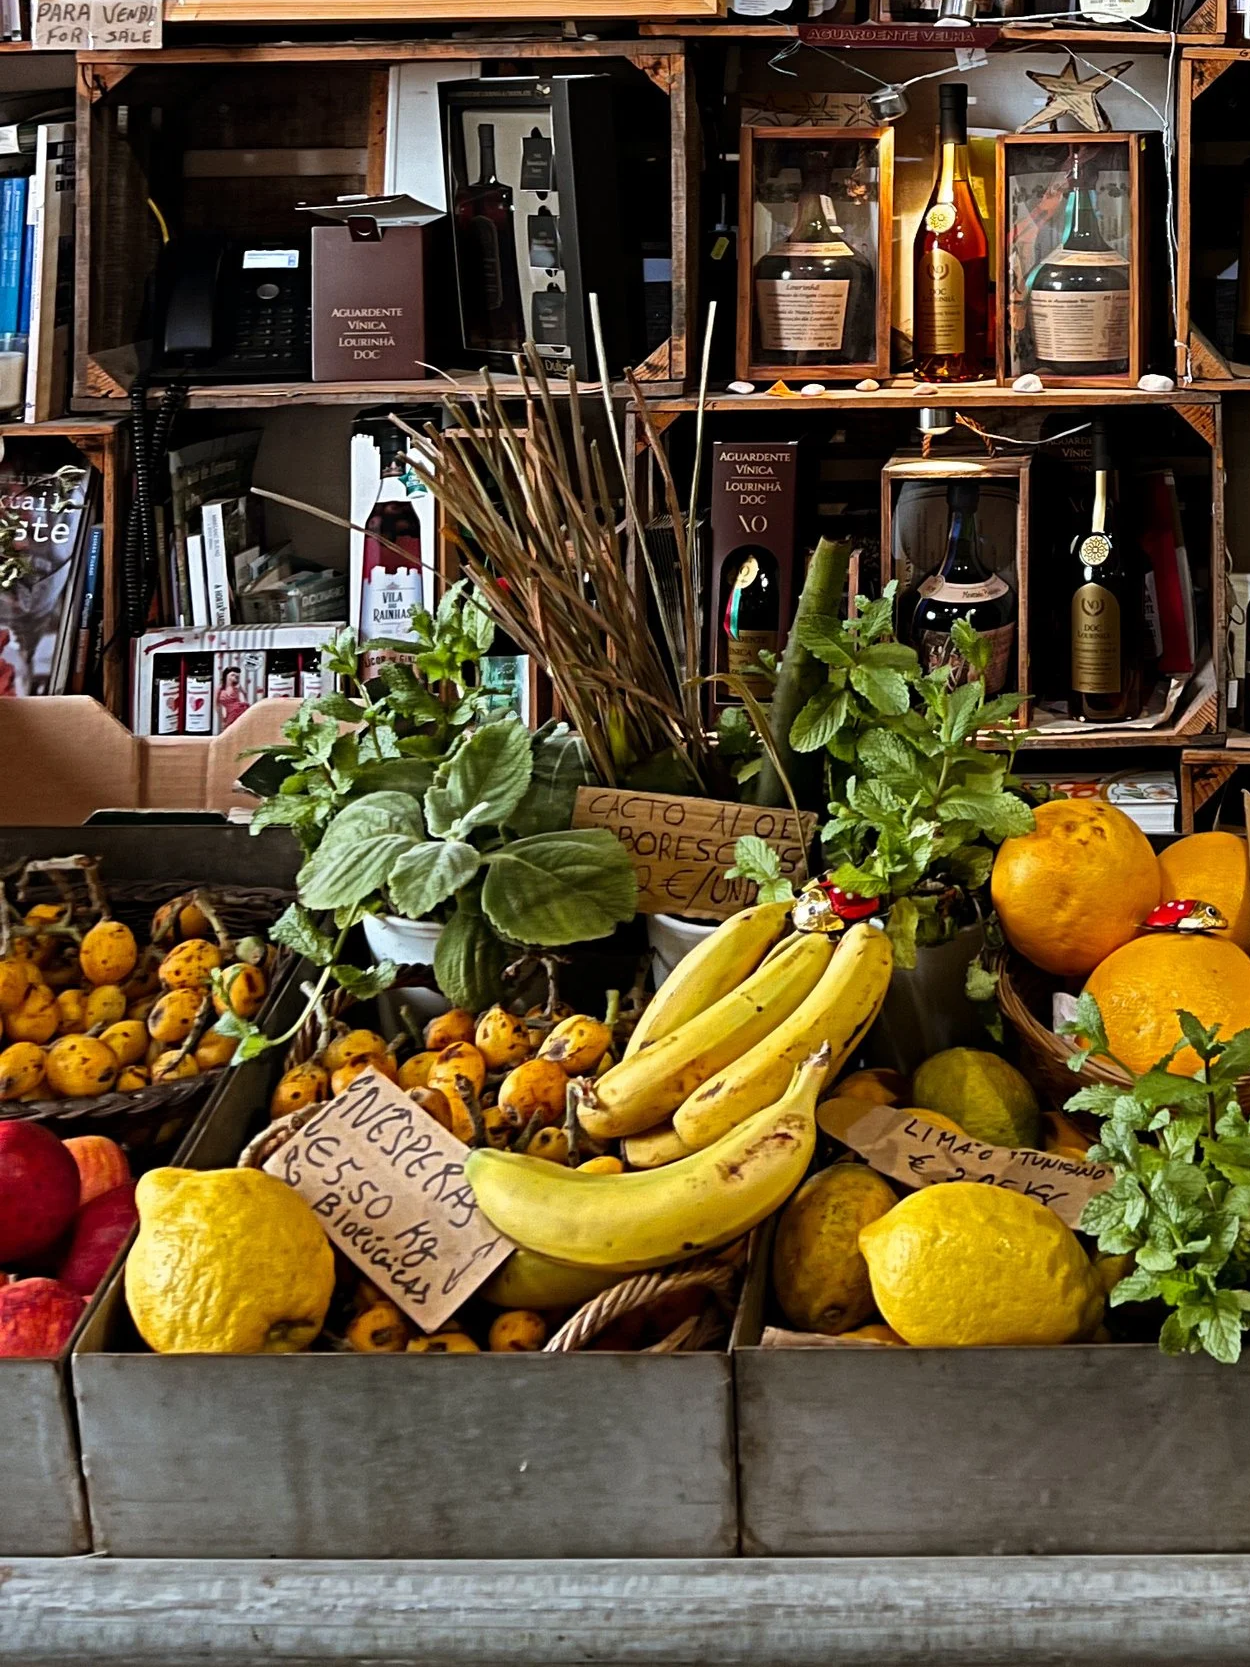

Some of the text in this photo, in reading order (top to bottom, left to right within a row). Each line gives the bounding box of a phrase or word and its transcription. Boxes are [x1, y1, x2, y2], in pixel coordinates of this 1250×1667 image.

[36, 2, 91, 24] PARA
[46, 25, 153, 45] FOR SALE
[805, 27, 976, 42] AGUARDENTE VELHA
[331, 307, 403, 318] AGUARDENTE
[347, 319, 387, 331] VÍNICA
[338, 336, 396, 348] LOURINHÃ
[354, 349, 381, 360] DOC
[718, 450, 792, 464] AGUARDENTE
[734, 462, 774, 476] VÍNICA
[725, 480, 782, 493] LOURINHÃ
[739, 494, 767, 505] DOC
[381, 591, 404, 605] VILA
[372, 608, 412, 622] RAINHAS
[1083, 624, 1101, 632] DOC
[588, 794, 798, 840] CACTO ALOE
[903, 1118, 994, 1161] LIMÃO
